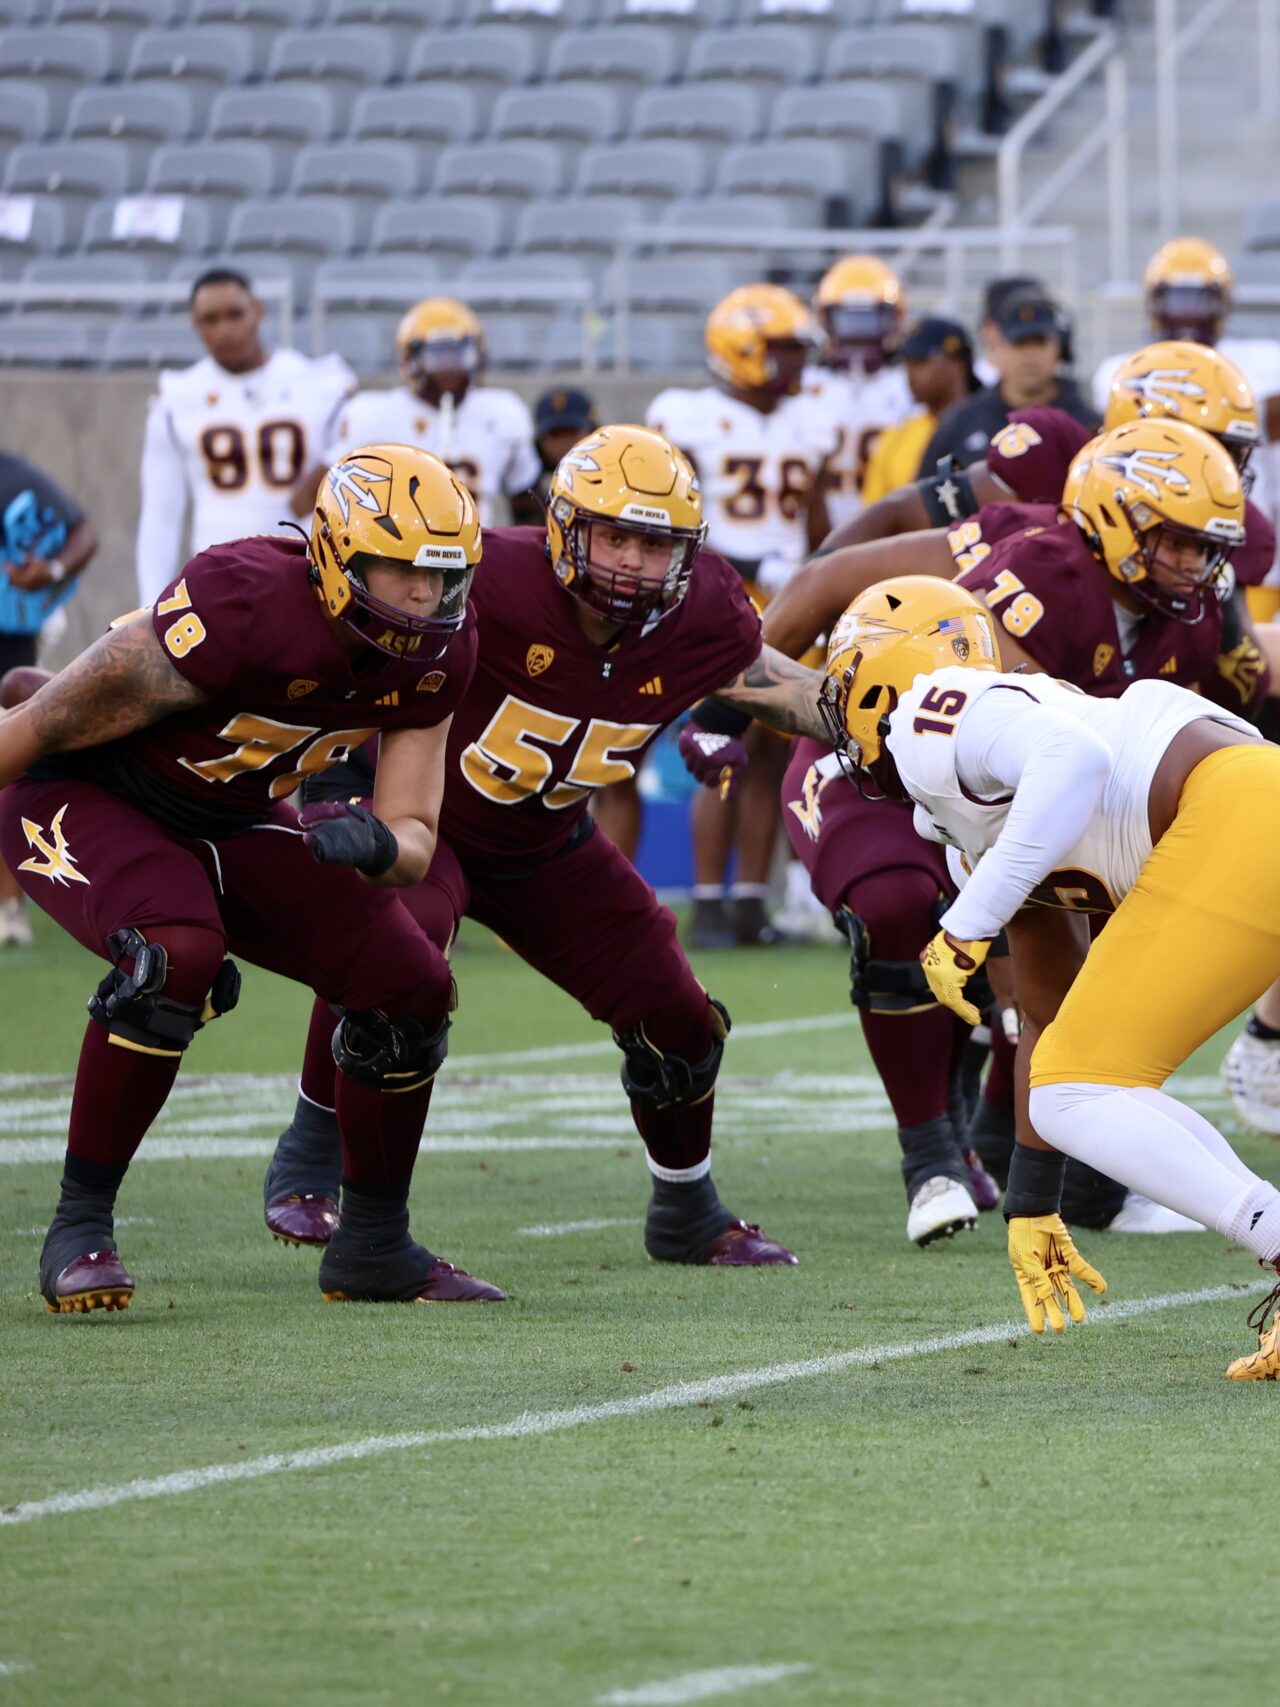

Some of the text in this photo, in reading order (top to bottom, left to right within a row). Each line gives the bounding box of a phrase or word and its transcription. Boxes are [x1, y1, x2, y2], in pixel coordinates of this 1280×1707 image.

[201, 419, 305, 491] 90
[629, 507, 666, 520] SUN DEVILS
[425, 549, 462, 560] SUN DEVILS
[157, 577, 207, 659] 78
[985, 568, 1045, 638] 79
[376, 629, 424, 653] ASU
[913, 685, 968, 737] 15
[459, 694, 663, 811] 55
